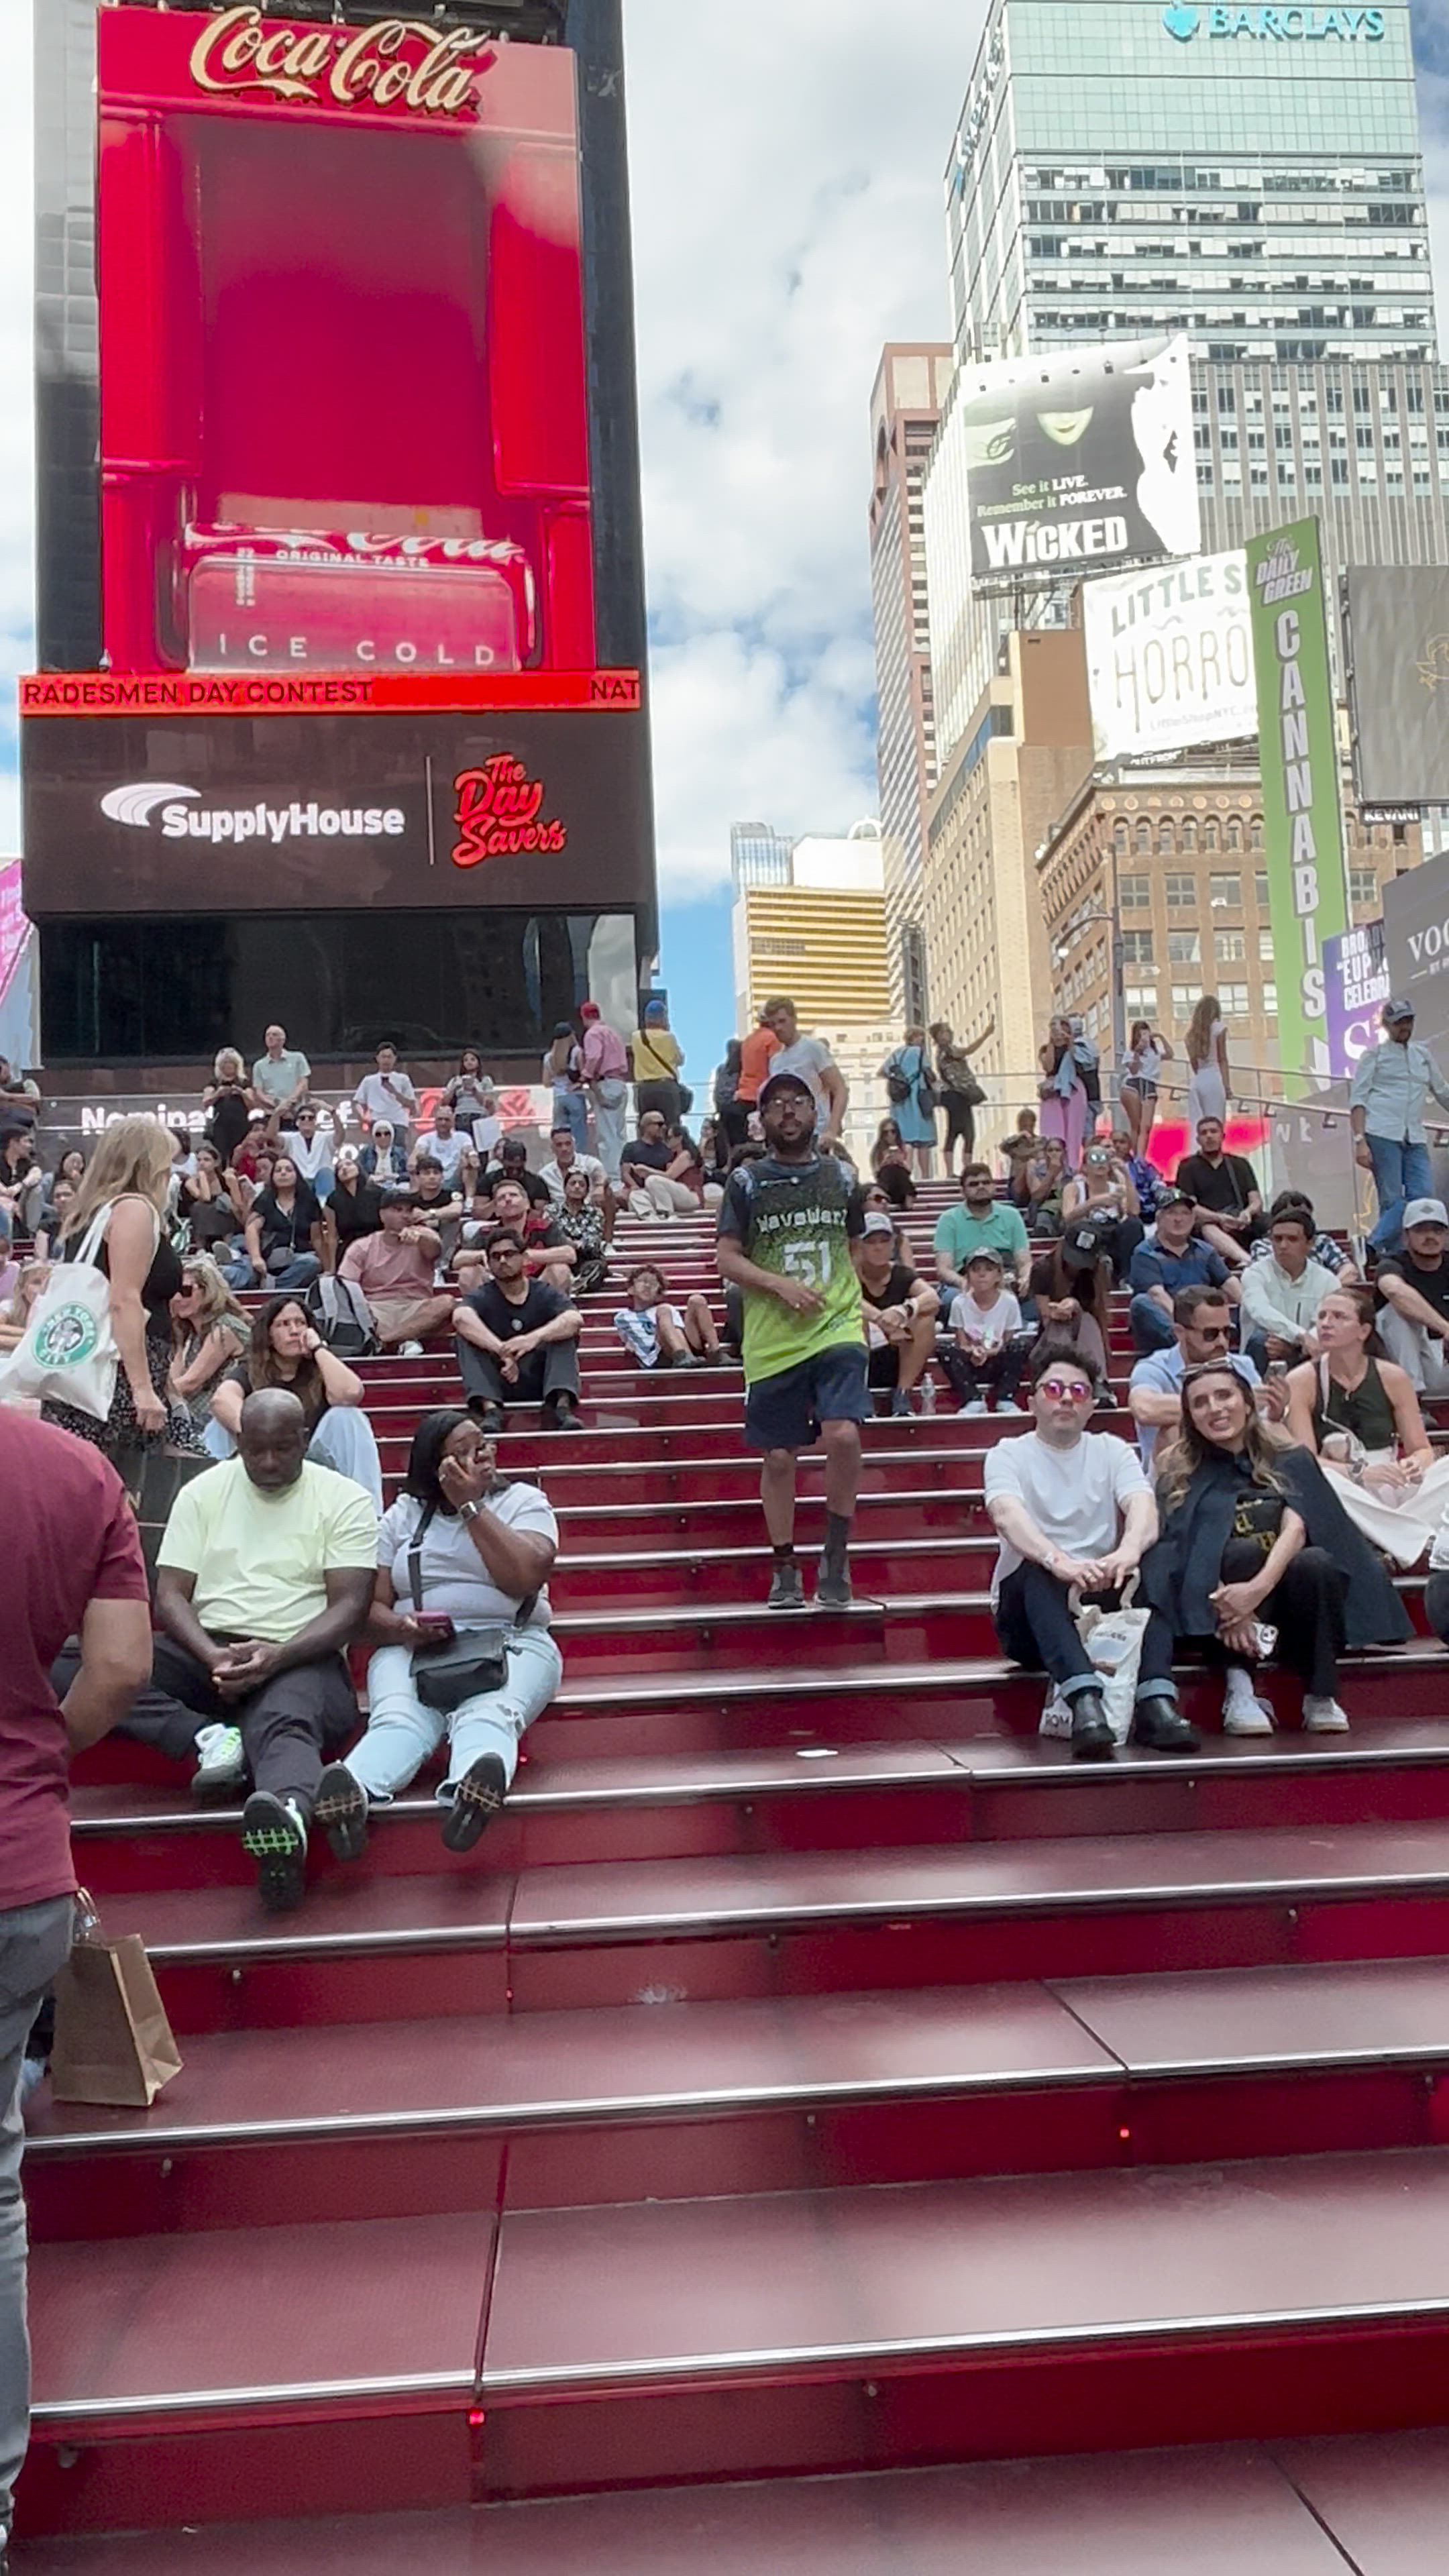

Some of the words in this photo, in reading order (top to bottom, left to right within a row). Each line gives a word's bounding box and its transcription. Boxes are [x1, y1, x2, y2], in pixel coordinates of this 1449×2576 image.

[1210, 7, 1385, 40] BARCLAYS
[977, 499, 1044, 517] Remember
[1047, 496, 1057, 508] it
[1059, 486, 1128, 506] FOREVER.
[1012, 483, 1036, 496] See
[1039, 480, 1049, 492] it
[1052, 475, 1089, 491] LIVE.
[276, 549, 364, 564] ORIGINAL
[1256, 548, 1300, 586] DAILY
[1112, 566, 1214, 637] LITTLE
[1263, 566, 1313, 604] GREEN
[219, 634, 307, 658] ICE
[356, 641, 495, 665] COLD
[24, 683, 178, 704] RADESMEN
[189, 682, 239, 704] DAY
[246, 681, 373, 702] CONTEST
[592, 679, 639, 700] NAT
[1114, 625, 1249, 733] HORRO
[485, 754, 527, 783] The
[453, 770, 543, 826] Day
[1277, 609, 1327, 1018] CANNABIS
[161, 803, 406, 843] SupplyHouse
[452, 812, 567, 866] Savers
